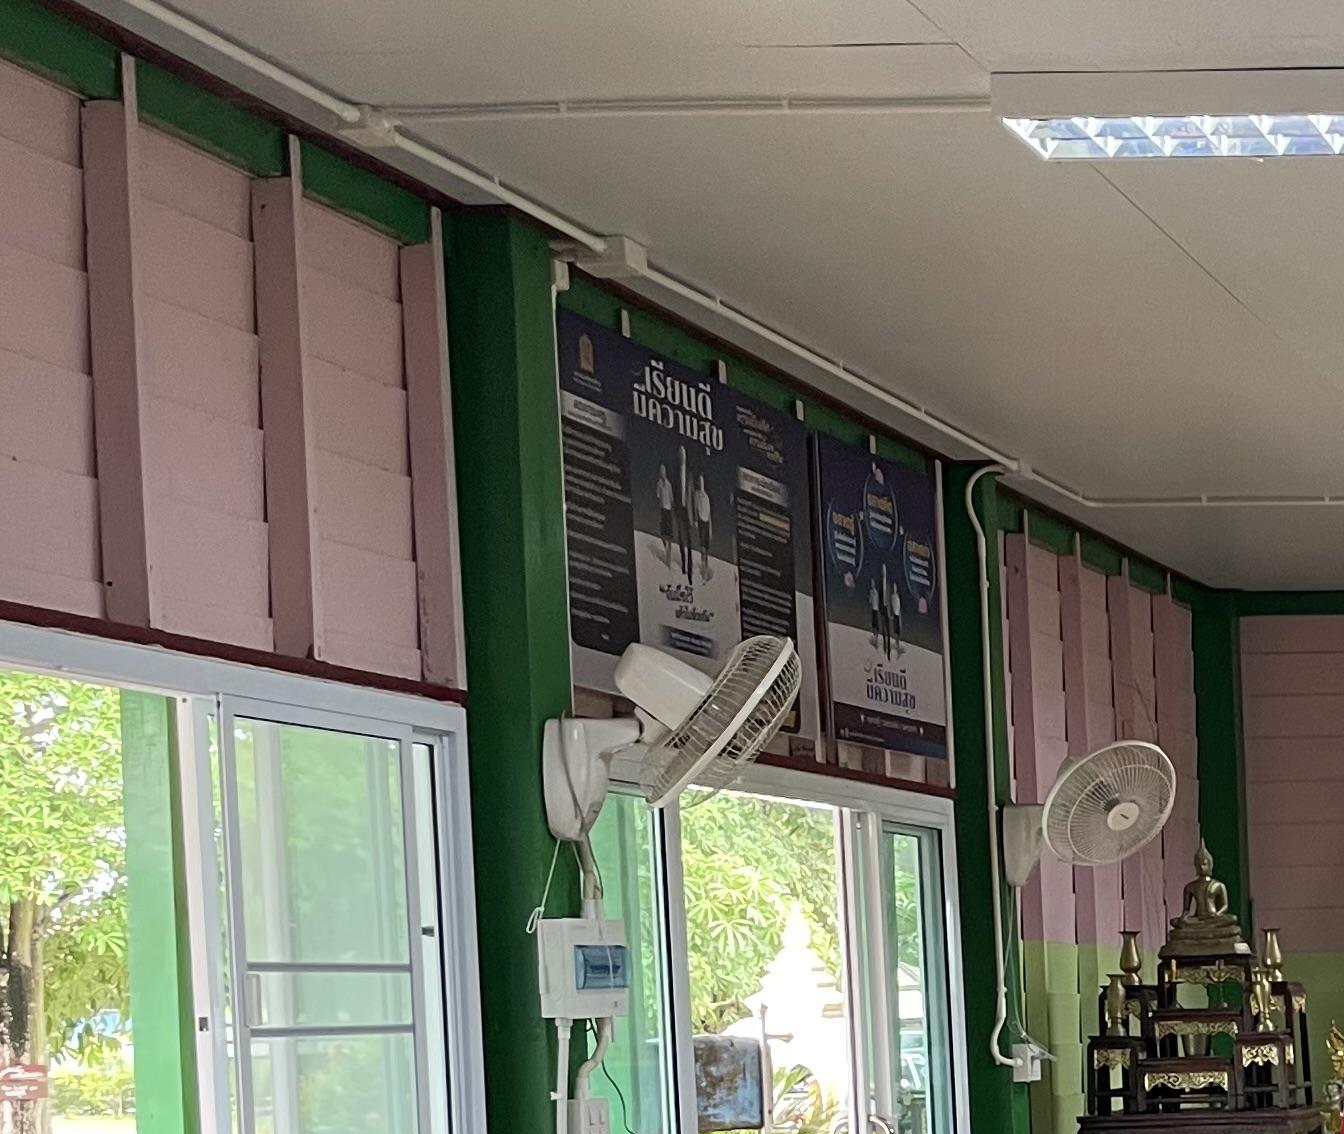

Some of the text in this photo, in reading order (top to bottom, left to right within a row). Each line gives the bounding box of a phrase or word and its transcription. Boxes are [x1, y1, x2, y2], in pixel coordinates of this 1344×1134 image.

[632, 383, 724, 456] มีความสุข
[644, 360, 713, 422] เรียนดี
